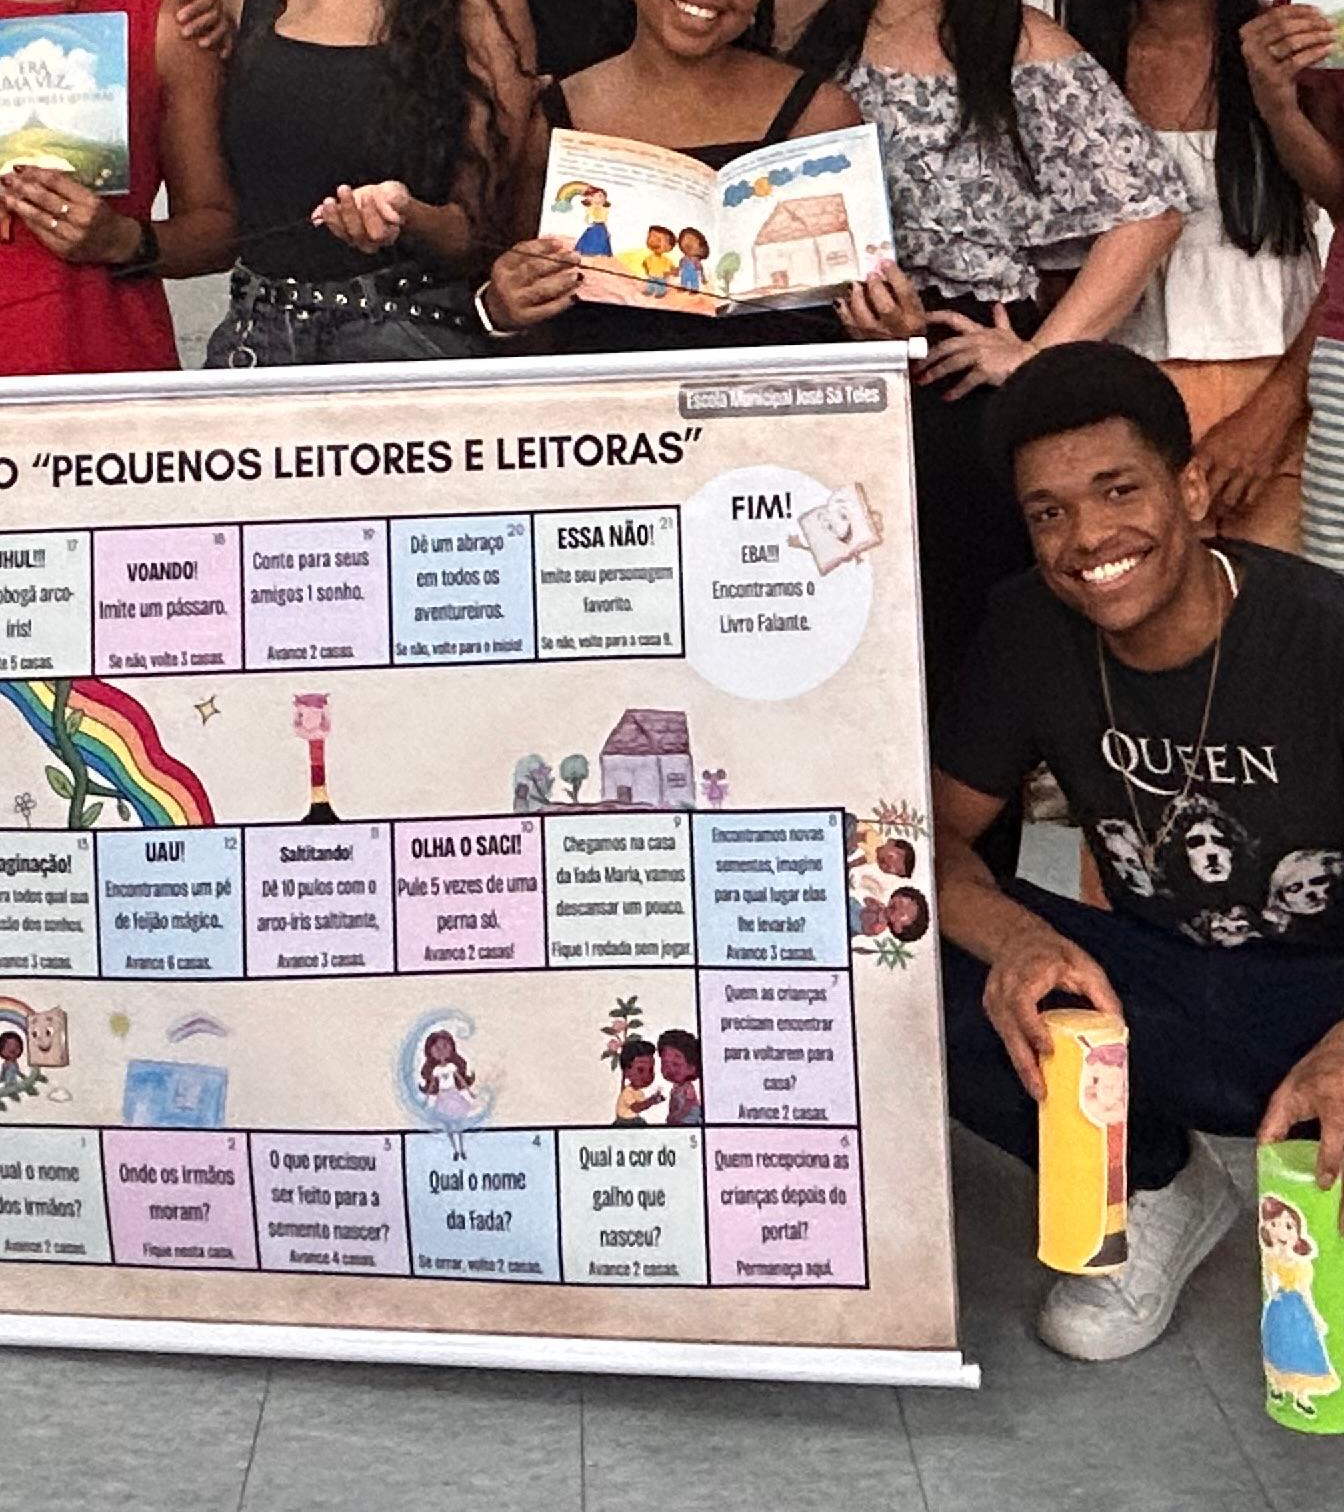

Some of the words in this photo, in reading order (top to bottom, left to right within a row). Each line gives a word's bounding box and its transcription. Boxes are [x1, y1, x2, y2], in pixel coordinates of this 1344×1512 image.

[31, 448, 262, 488] “PEQUENOS
[275, 439, 452, 480] LEITORES
[465, 438, 485, 472] E
[497, 427, 702, 470] LEITORAS”
[732, 492, 791, 520] FIM!
[411, 534, 428, 554] Dê
[431, 537, 453, 553] um
[457, 533, 504, 555] abraço
[557, 526, 605, 549] ESSA
[609, 520, 654, 547] NÃO!
[127, 561, 197, 582] VOANDO!
[253, 551, 294, 570] Conte
[299, 553, 331, 571] para
[335, 551, 369, 567] seus
[417, 572, 437, 587] em
[441, 567, 480, 587] todos
[483, 569, 499, 585] os
[251, 585, 303, 607] amigos
[307, 584, 312, 601] 1
[317, 582, 365, 602] sonho.
[712, 581, 803, 599] Encontramos
[807, 581, 815, 596] o
[99, 599, 135, 619] Imite
[140, 602, 163, 618] um
[167, 597, 227, 620] pássaro.
[720, 615, 754, 633] Livro
[757, 613, 811, 632] Falante.
[1101, 728, 1280, 796] QUEEN
[145, 841, 185, 863] UAU!
[280, 845, 353, 863] Saltitando!
[411, 837, 456, 859] OLHA
[460, 836, 471, 857] O
[476, 832, 521, 856] SACI!
[563, 836, 627, 855] Chegamos
[630, 837, 645, 851] na
[647, 837, 676, 851] casa
[398, 876, 427, 896] Pule
[431, 877, 439, 896] 5
[443, 879, 483, 895] vezes
[486, 875, 503, 893] de
[507, 877, 537, 893] uma
[556, 867, 571, 885] da
[573, 866, 601, 883] fada
[105, 880, 189, 898] Encontramos
[191, 882, 212, 897] um
[215, 878, 231, 899] pé
[262, 879, 279, 898] Dê
[282, 879, 295, 897] 10
[297, 878, 333, 899] pulos
[337, 880, 365, 895] com
[368, 879, 377, 895] o
[115, 912, 131, 929] de
[437, 914, 477, 934] perna
[269, 1149, 280, 1169] O
[283, 1153, 310, 1173] que
[313, 1152, 376, 1173] precisou
[579, 1145, 612, 1171] Qual
[616, 1150, 625, 1167] a
[629, 1149, 653, 1167] cor
[657, 1145, 675, 1167] do
[715, 1150, 753, 1171] Quem
[756, 1150, 830, 1171] recepciona
[833, 1148, 849, 1170] as
[25, 1165, 35, 1180] o
[38, 1165, 80, 1183] nome
[119, 1163, 157, 1184] Onde
[161, 1168, 179, 1185] os
[182, 1165, 235, 1186] irmãos
[429, 1169, 463, 1195] Qual
[469, 1173, 478, 1191] o
[482, 1172, 526, 1191] nome
[24, 1197, 82, 1217] irmãos?
[271, 1187, 295, 1204] ser
[297, 1185, 331, 1205] feito
[335, 1191, 367, 1209] para
[371, 1191, 380, 1207] a
[593, 1186, 633, 1211] galho
[637, 1189, 665, 1211] que
[721, 1186, 779, 1210] crianças
[781, 1185, 826, 1207] depois
[829, 1186, 847, 1205] do
[149, 1202, 211, 1221] moram?
[447, 1209, 465, 1231] da
[469, 1210, 512, 1231] fada?
[268, 1221, 330, 1240] semente
[333, 1223, 390, 1242] nascer?
[600, 1226, 661, 1247] nasceu?
[761, 1221, 808, 1244] portal?
